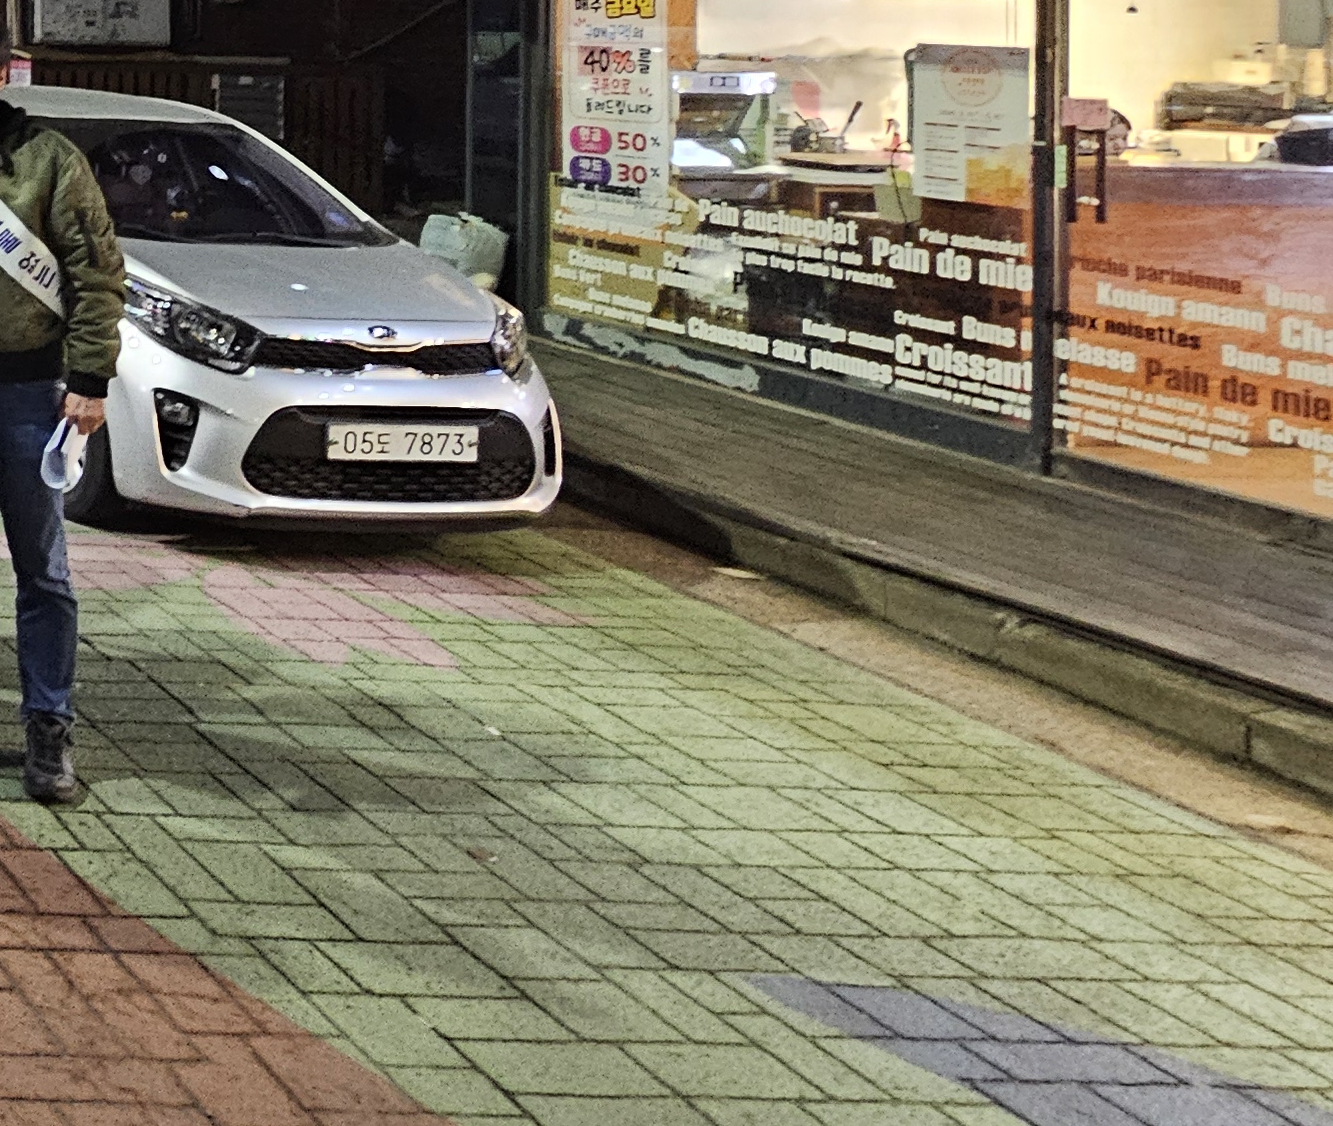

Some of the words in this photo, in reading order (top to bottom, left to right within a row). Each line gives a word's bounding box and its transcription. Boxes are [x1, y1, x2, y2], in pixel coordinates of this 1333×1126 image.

[697, 198, 740, 227] Pain
[18, 251, 58, 287] 없는
[872, 236, 930, 274] Pain
[936, 248, 972, 282] de
[979, 257, 1033, 292] mie
[1145, 357, 1210, 398] Pain
[1220, 374, 1260, 408] de
[1270, 387, 1332, 423] mie
[404, 431, 467, 457] 7873
